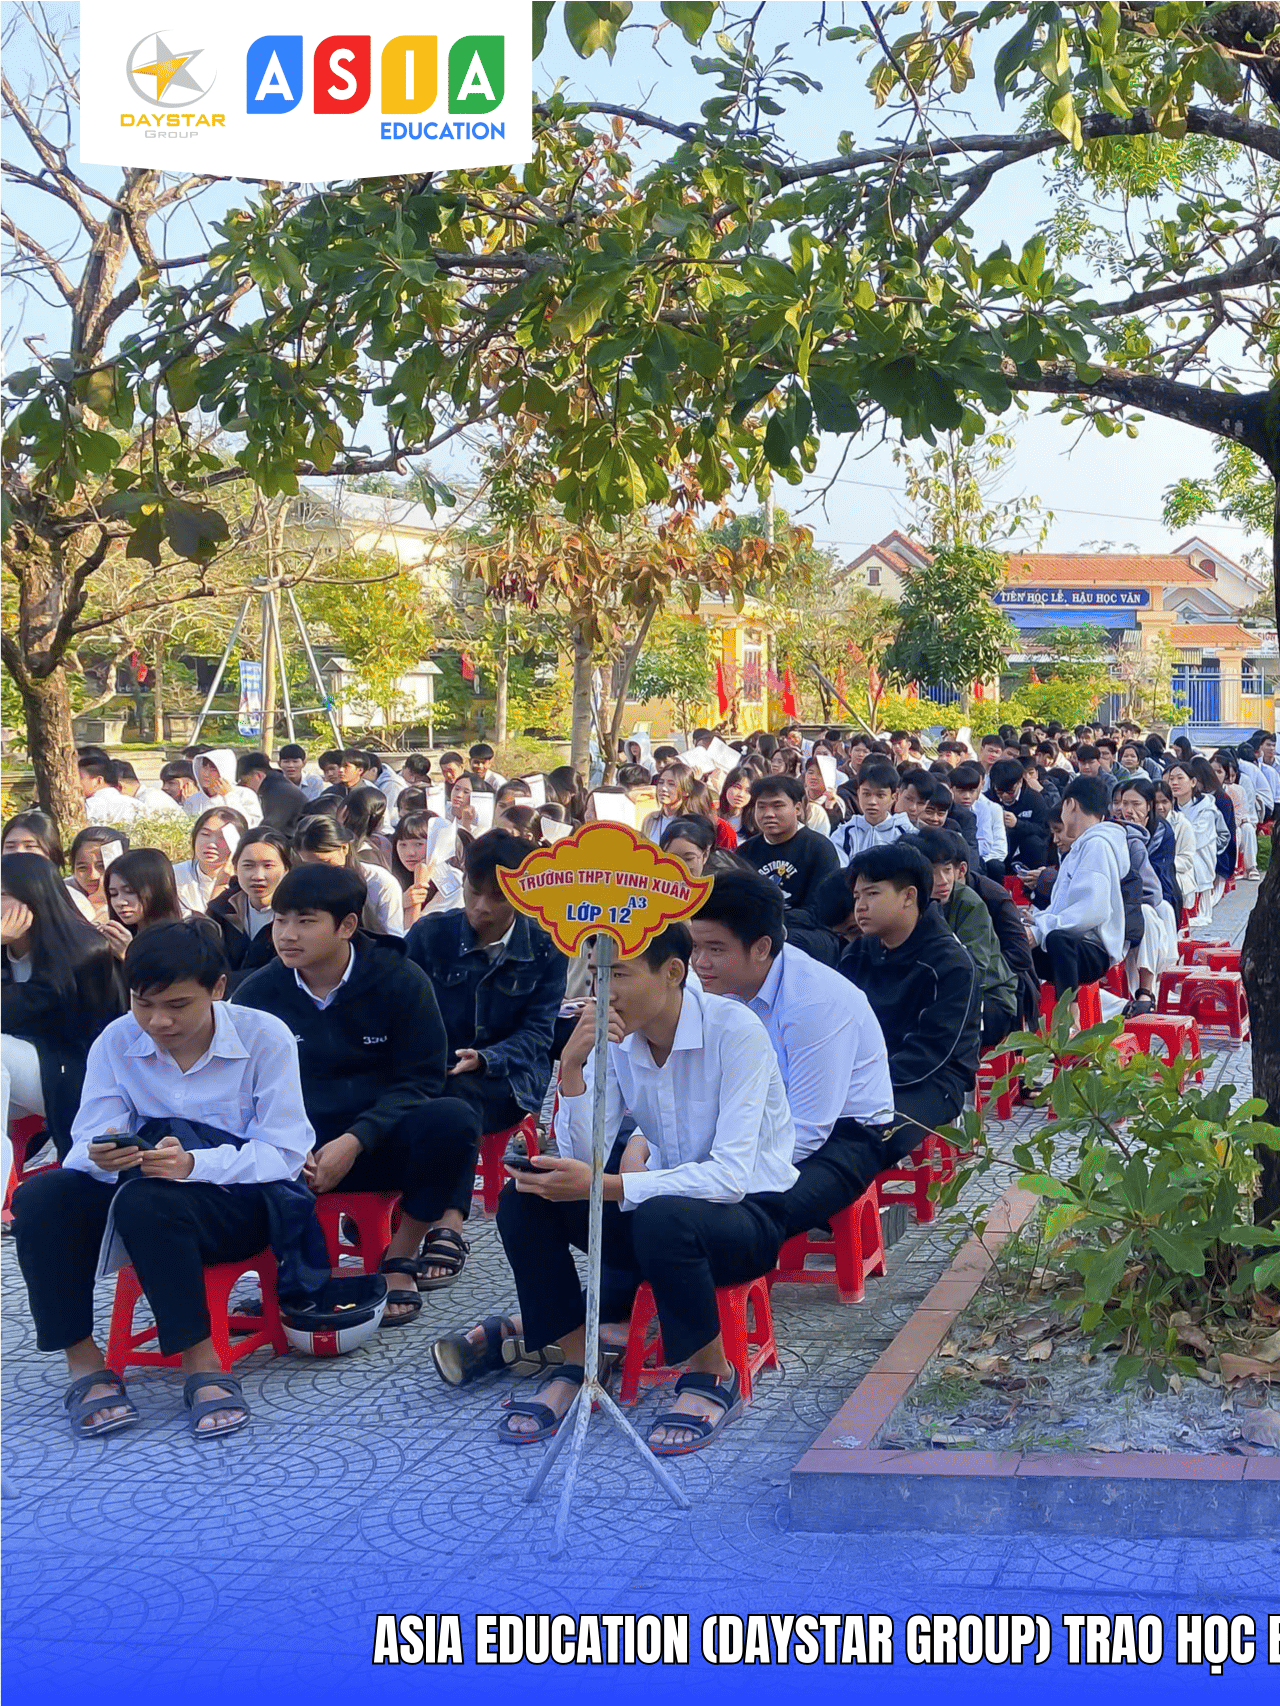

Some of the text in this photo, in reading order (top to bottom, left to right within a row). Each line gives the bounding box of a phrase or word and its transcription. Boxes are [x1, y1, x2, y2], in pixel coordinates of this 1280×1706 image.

[1096, 593, 1117, 604] HỌC
[1120, 591, 1141, 604] VĂN
[519, 869, 691, 902] TRƯỜNG THPT VINH XUÂN
[566, 901, 602, 922] LỚP
